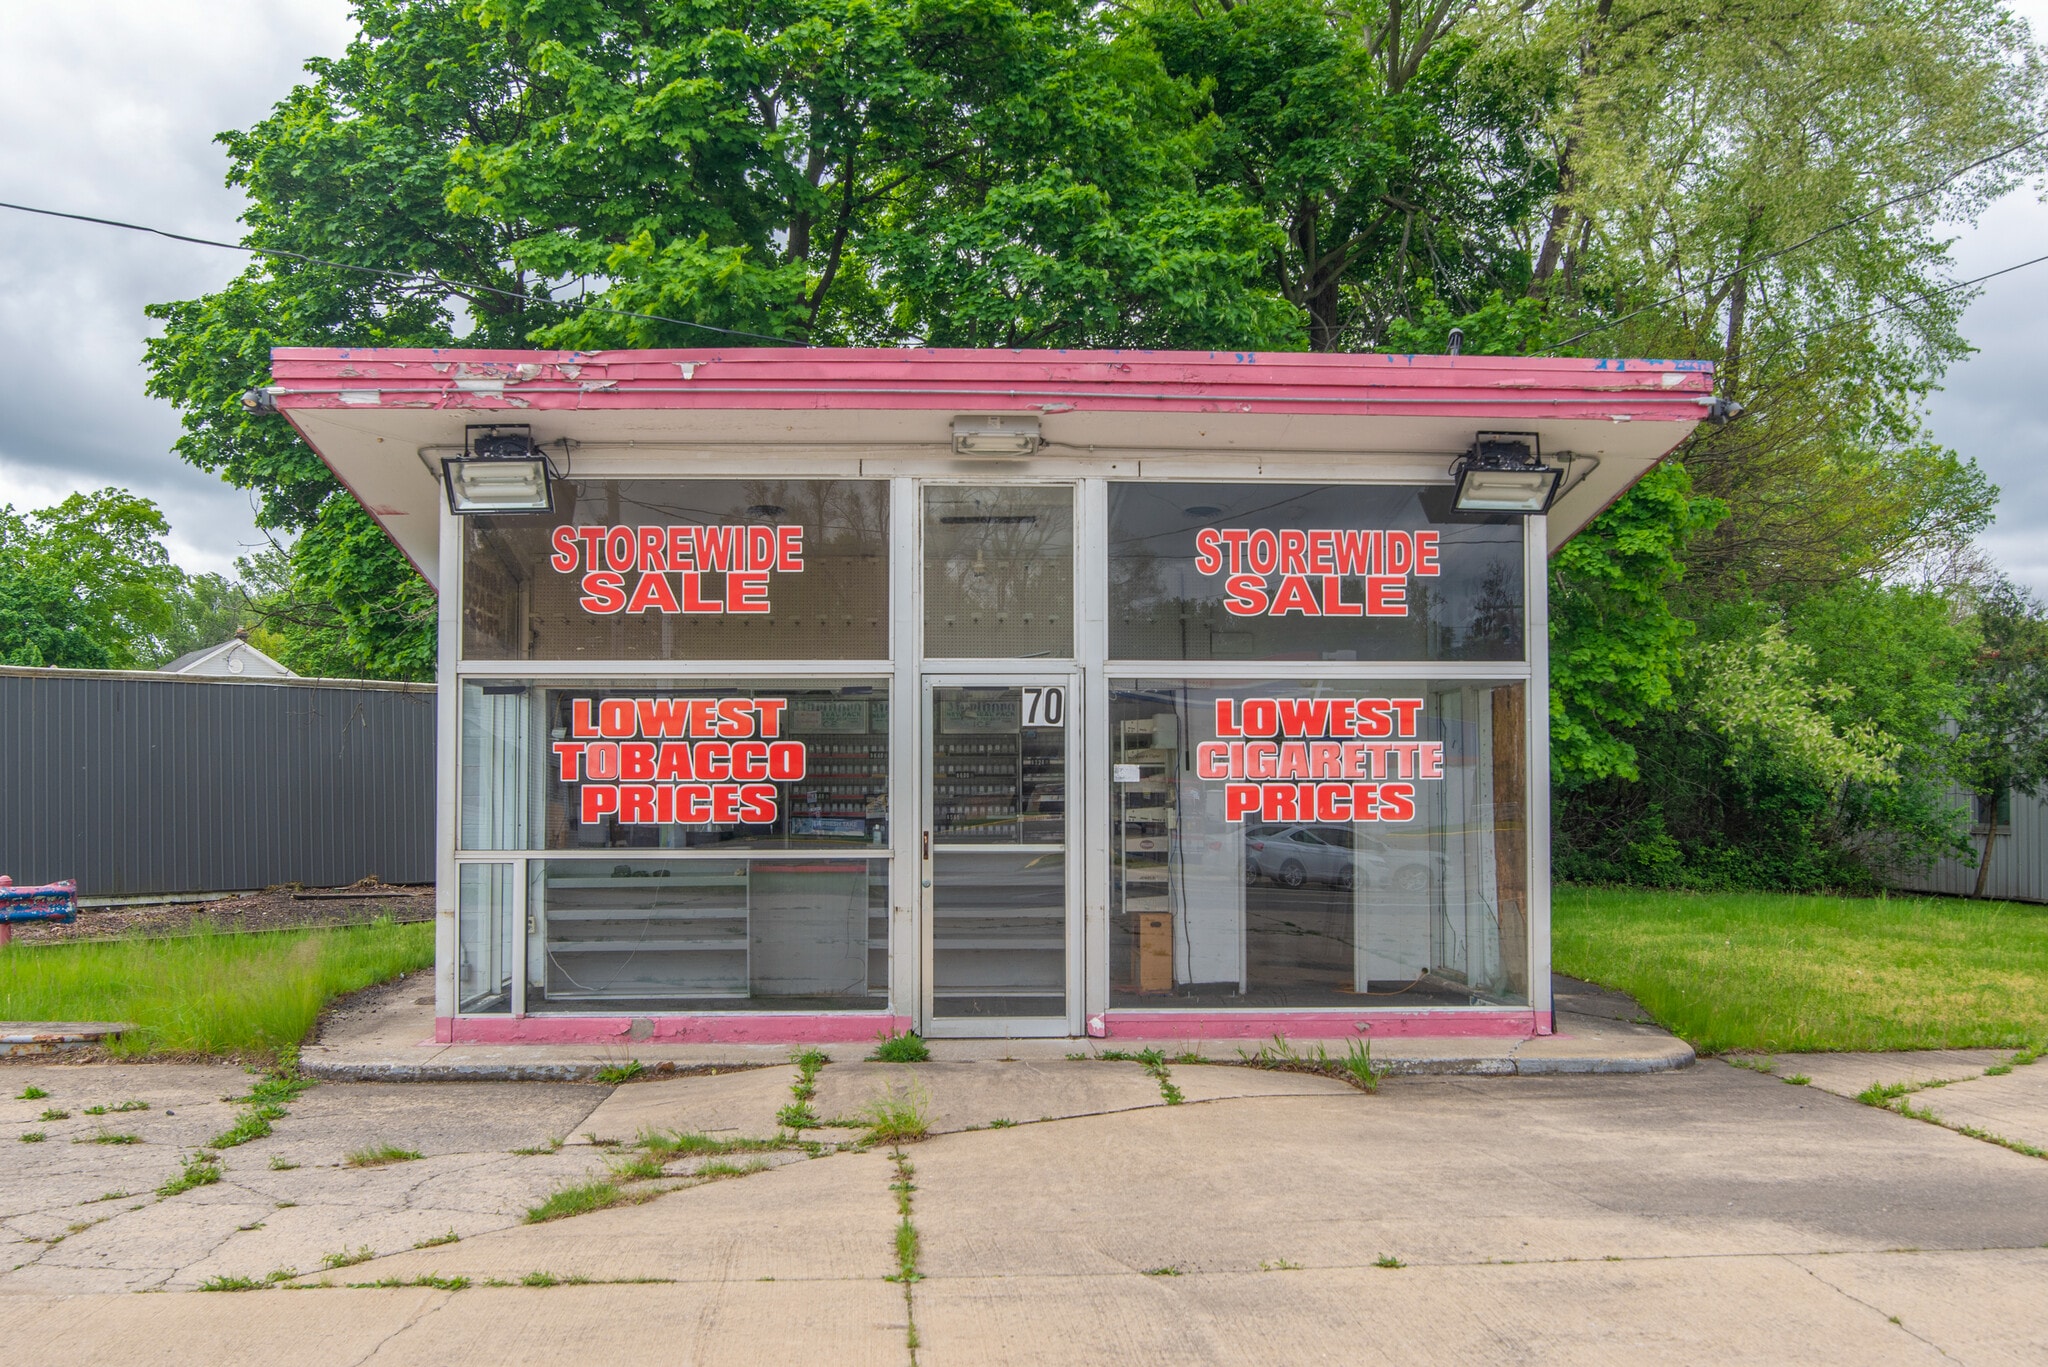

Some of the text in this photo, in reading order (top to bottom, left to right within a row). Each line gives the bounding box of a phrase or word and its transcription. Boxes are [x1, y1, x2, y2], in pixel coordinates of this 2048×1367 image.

[551, 525, 804, 573] STOREWIDE
[1195, 528, 1440, 576] STOREWIDE
[580, 572, 771, 614] SALE
[1224, 575, 1409, 617] SALE
[572, 698, 787, 739] LOWEST
[1024, 688, 1062, 724] 70
[1215, 698, 1423, 738] LOWEST
[552, 741, 806, 782] TOBACCO
[1196, 741, 1443, 780] CIGARETTE
[581, 783, 778, 824] PRICES
[1225, 783, 1415, 823] PRICES
